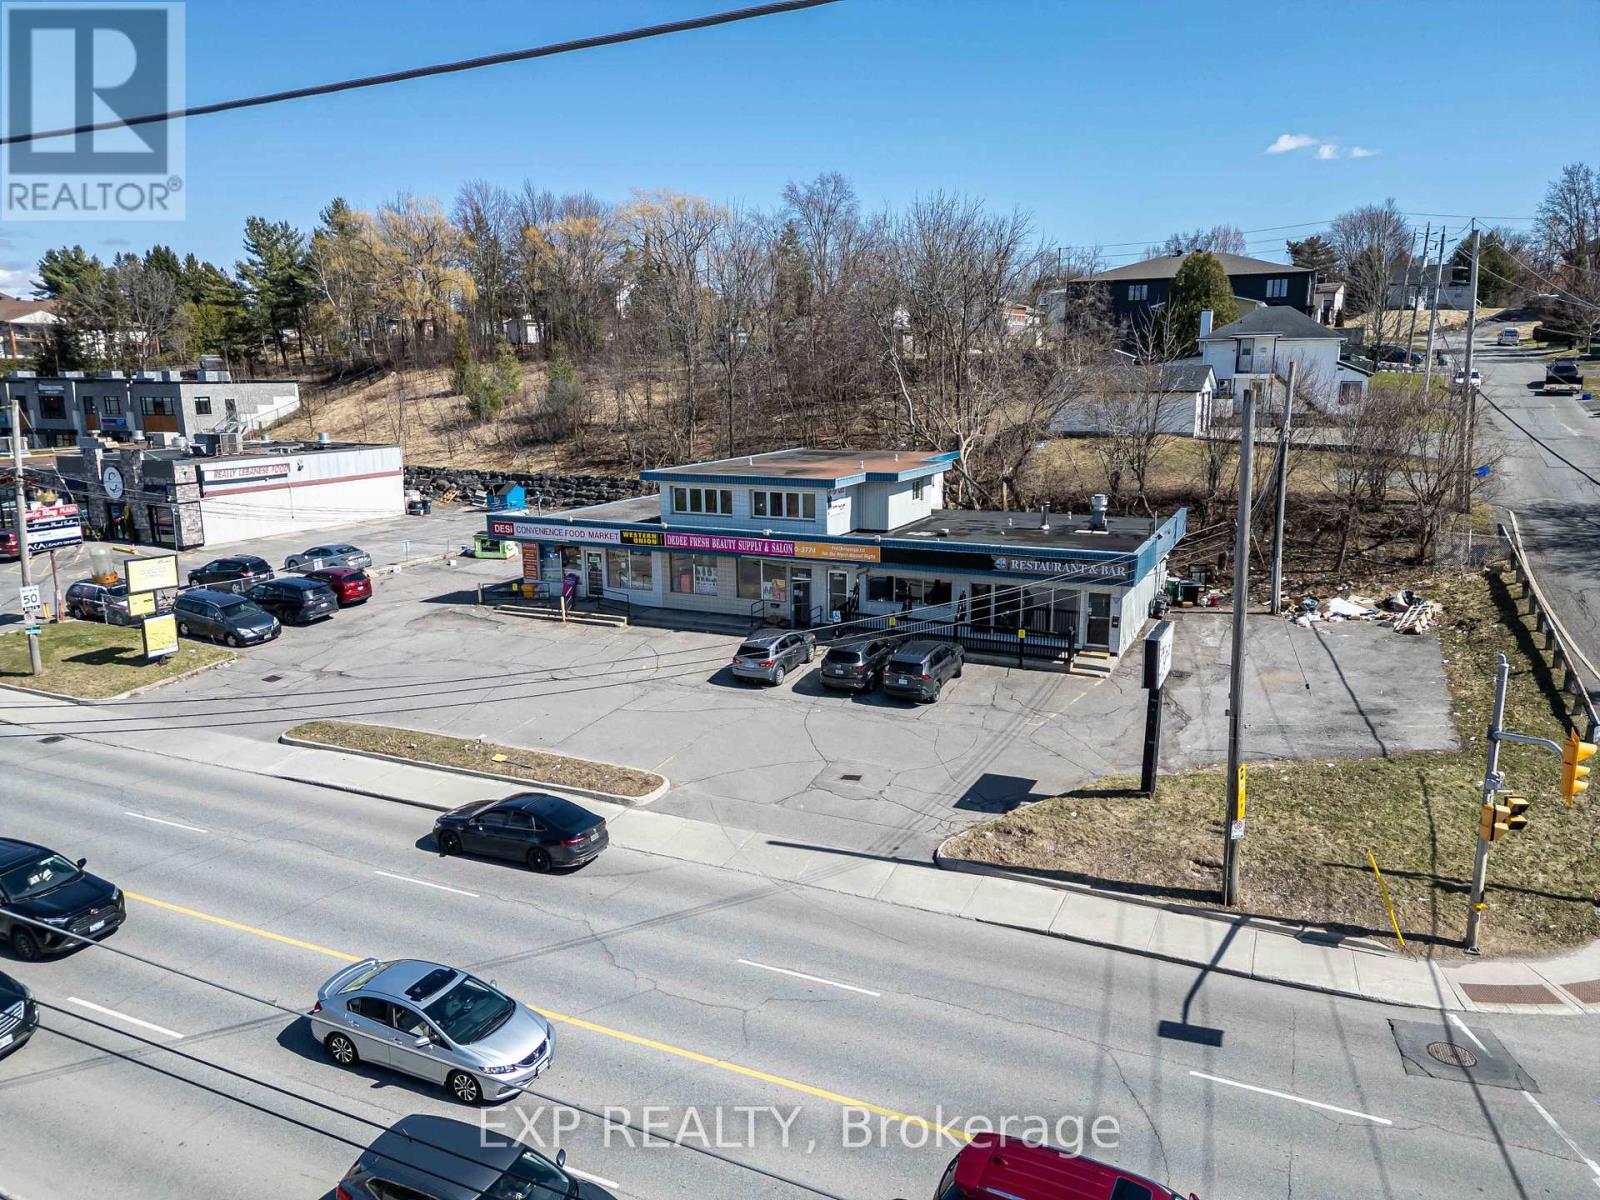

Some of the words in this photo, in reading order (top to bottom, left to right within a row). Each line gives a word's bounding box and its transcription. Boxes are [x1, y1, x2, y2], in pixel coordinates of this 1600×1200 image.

[214, 468, 236, 480] REALLY
[239, 466, 270, 477] LEBANESE
[271, 464, 289, 474] FOOD
[516, 525, 564, 537] CONVENIENCE
[565, 529, 586, 538] FOOD
[588, 531, 619, 540] MARKET
[623, 531, 657, 540] WESTERN
[634, 537, 657, 546] UNION
[667, 534, 688, 546] DEDEE
[690, 536, 710, 548] FRESH
[712, 537, 737, 550] BEAUTY
[738, 539, 762, 552] SUPPLY
[764, 542, 769, 552] &
[771, 542, 794, 555] SALON
[1011, 560, 1088, 574] RESTAURANT
[1089, 565, 1098, 574] &
[1100, 565, 1126, 577] BAR
[23, 593, 38, 605] 50
